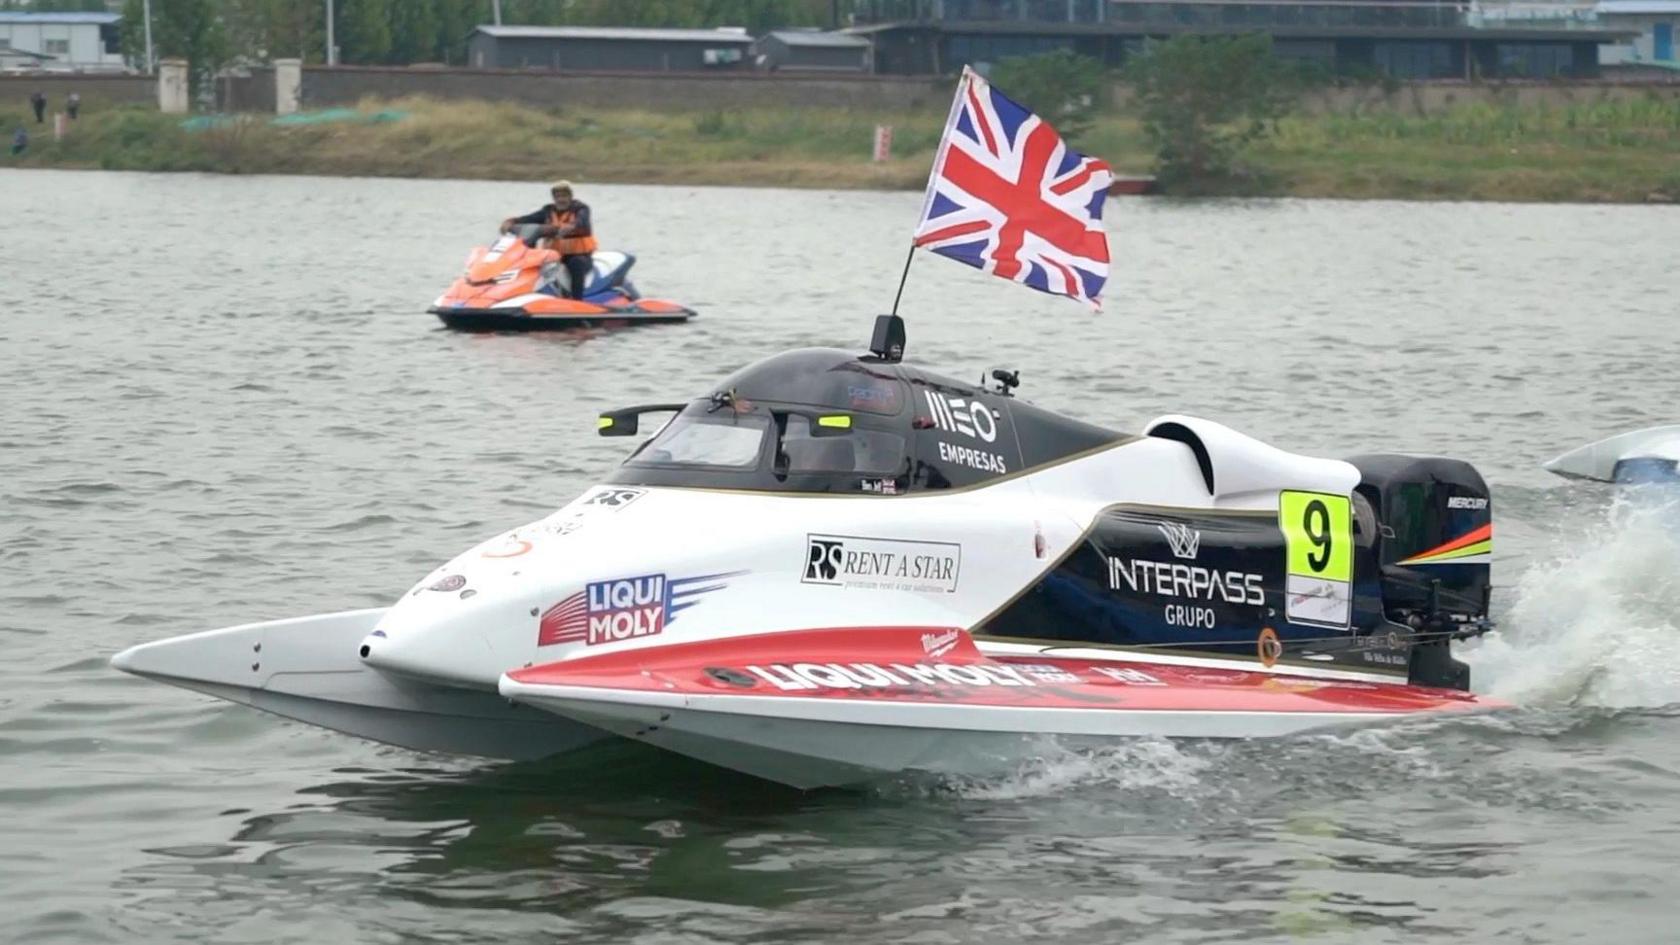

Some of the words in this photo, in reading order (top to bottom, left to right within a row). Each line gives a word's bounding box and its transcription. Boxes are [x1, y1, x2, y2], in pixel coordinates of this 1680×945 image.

[938, 441, 1007, 474] EMPRESAS
[1447, 496, 1489, 510] MERCURY
[1303, 499, 1332, 573] 9
[805, 540, 844, 580] RS
[844, 550, 896, 576] RENT
[896, 555, 908, 578] A
[912, 555, 954, 580] STAR
[589, 576, 663, 612] LIQUI
[1108, 556, 1265, 606] INTERPASS
[589, 606, 663, 644] MOLY
[1165, 604, 1216, 629] GRUPO
[745, 664, 909, 690] LIQUI
[890, 664, 1036, 687] MOLY
